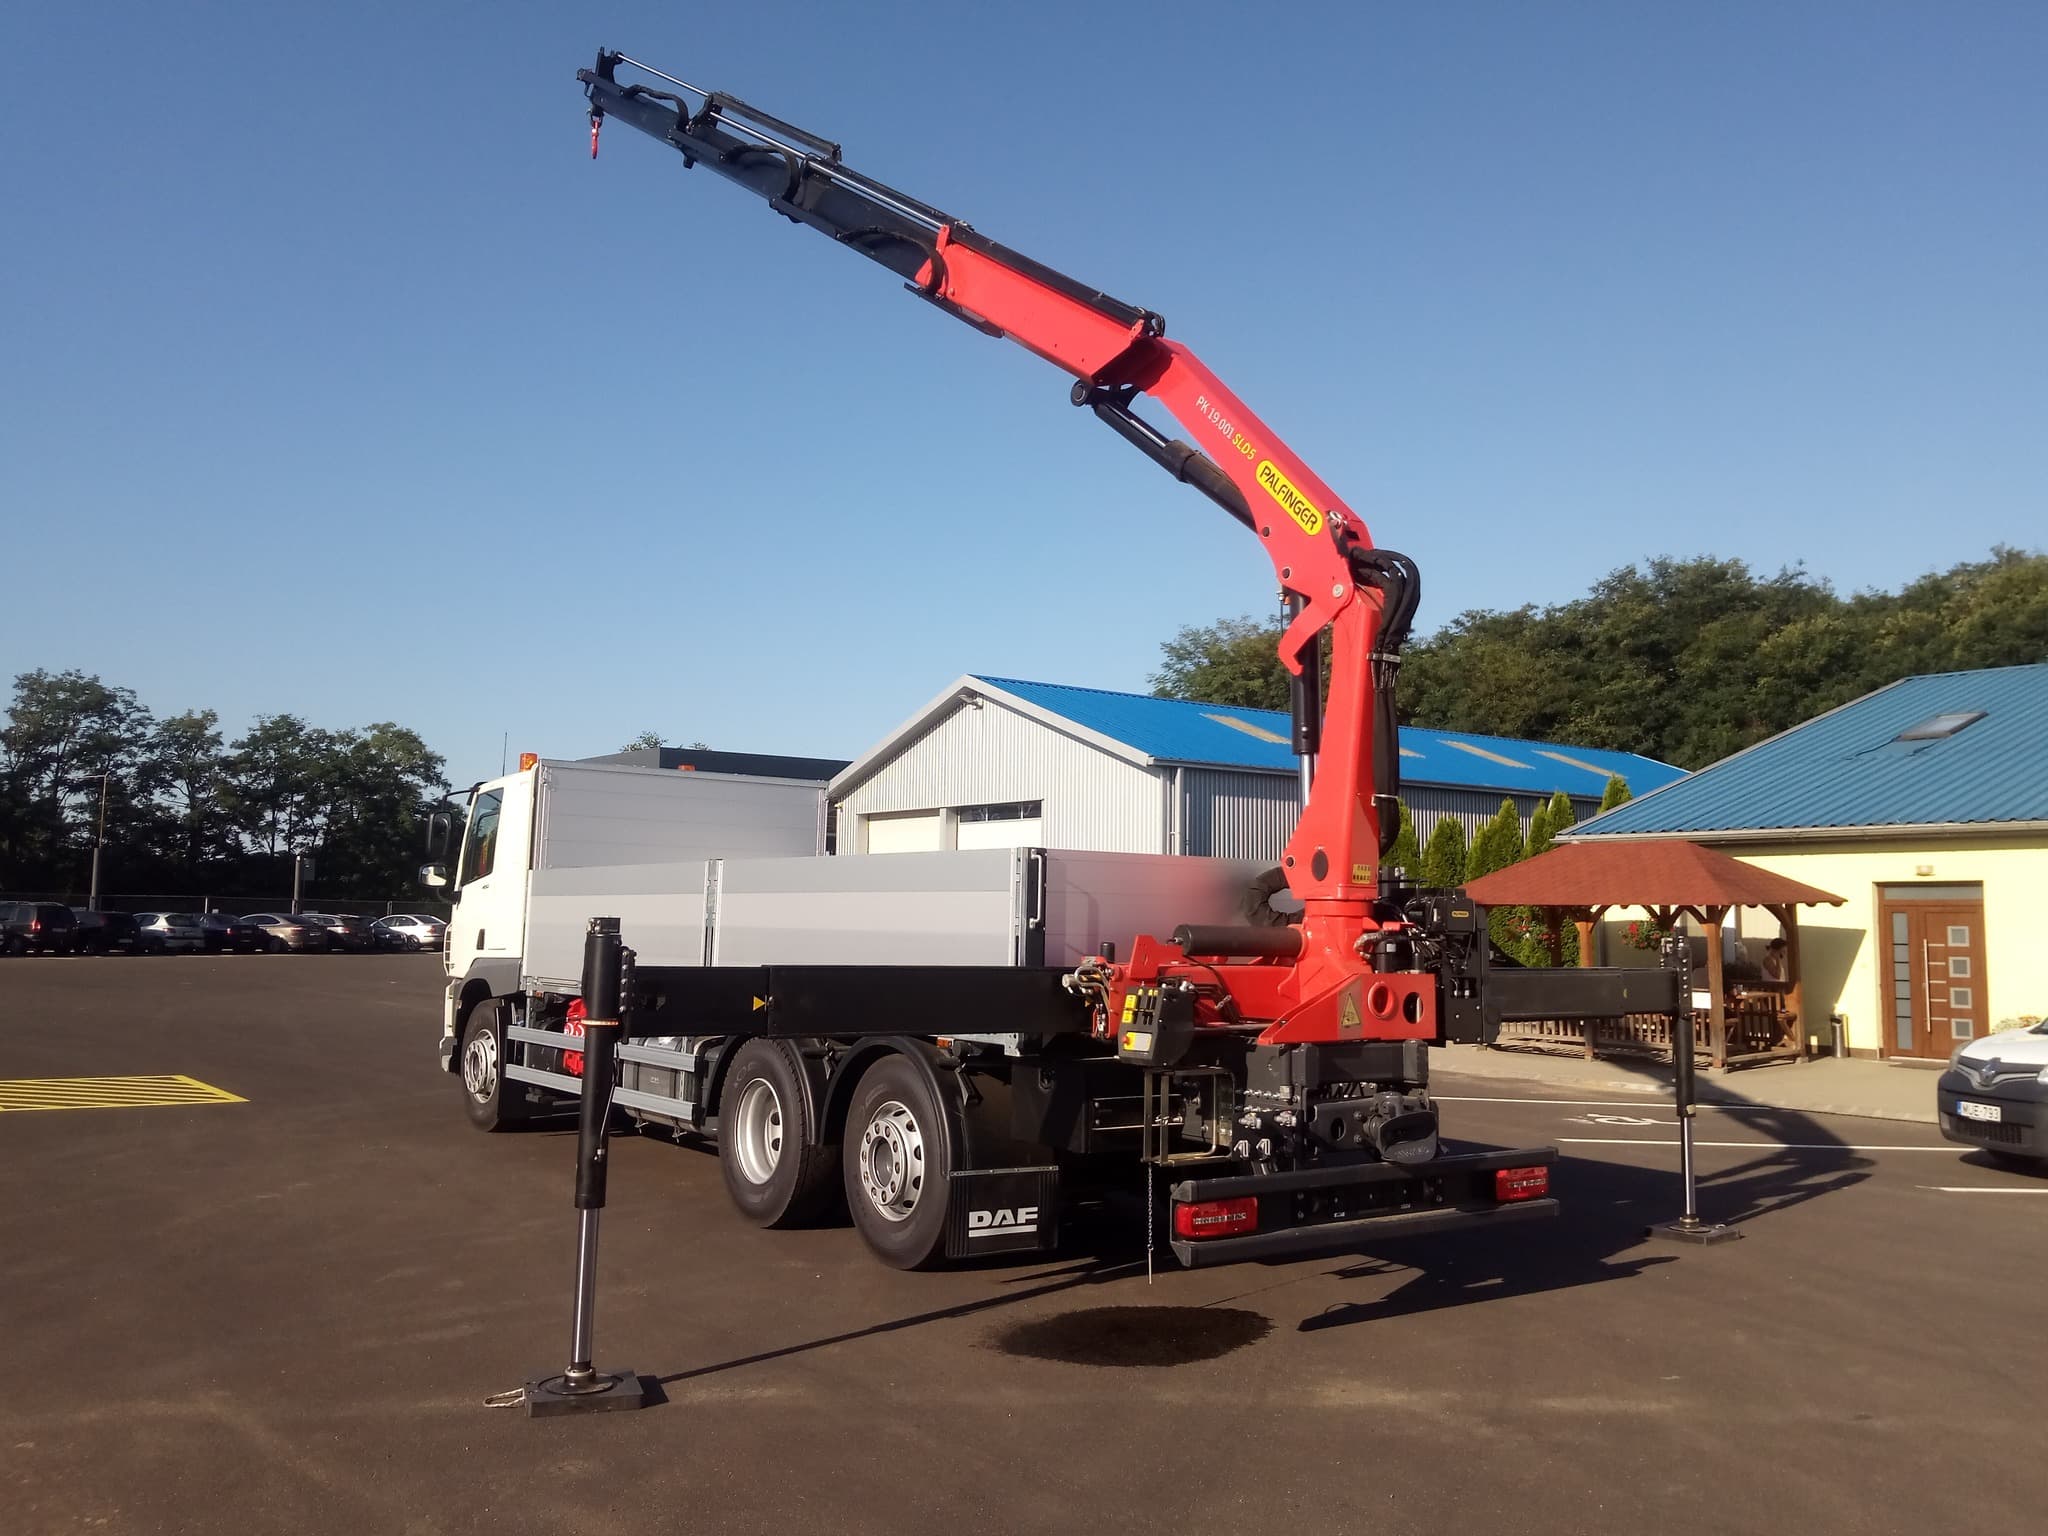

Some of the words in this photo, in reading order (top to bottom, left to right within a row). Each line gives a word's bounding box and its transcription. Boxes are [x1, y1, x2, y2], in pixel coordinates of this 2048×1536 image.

[1195, 395, 1210, 414] PK
[1207, 407, 1234, 440] 19.001
[1259, 465, 1318, 531] PALFINGER
[969, 1207, 1038, 1228] DAF
